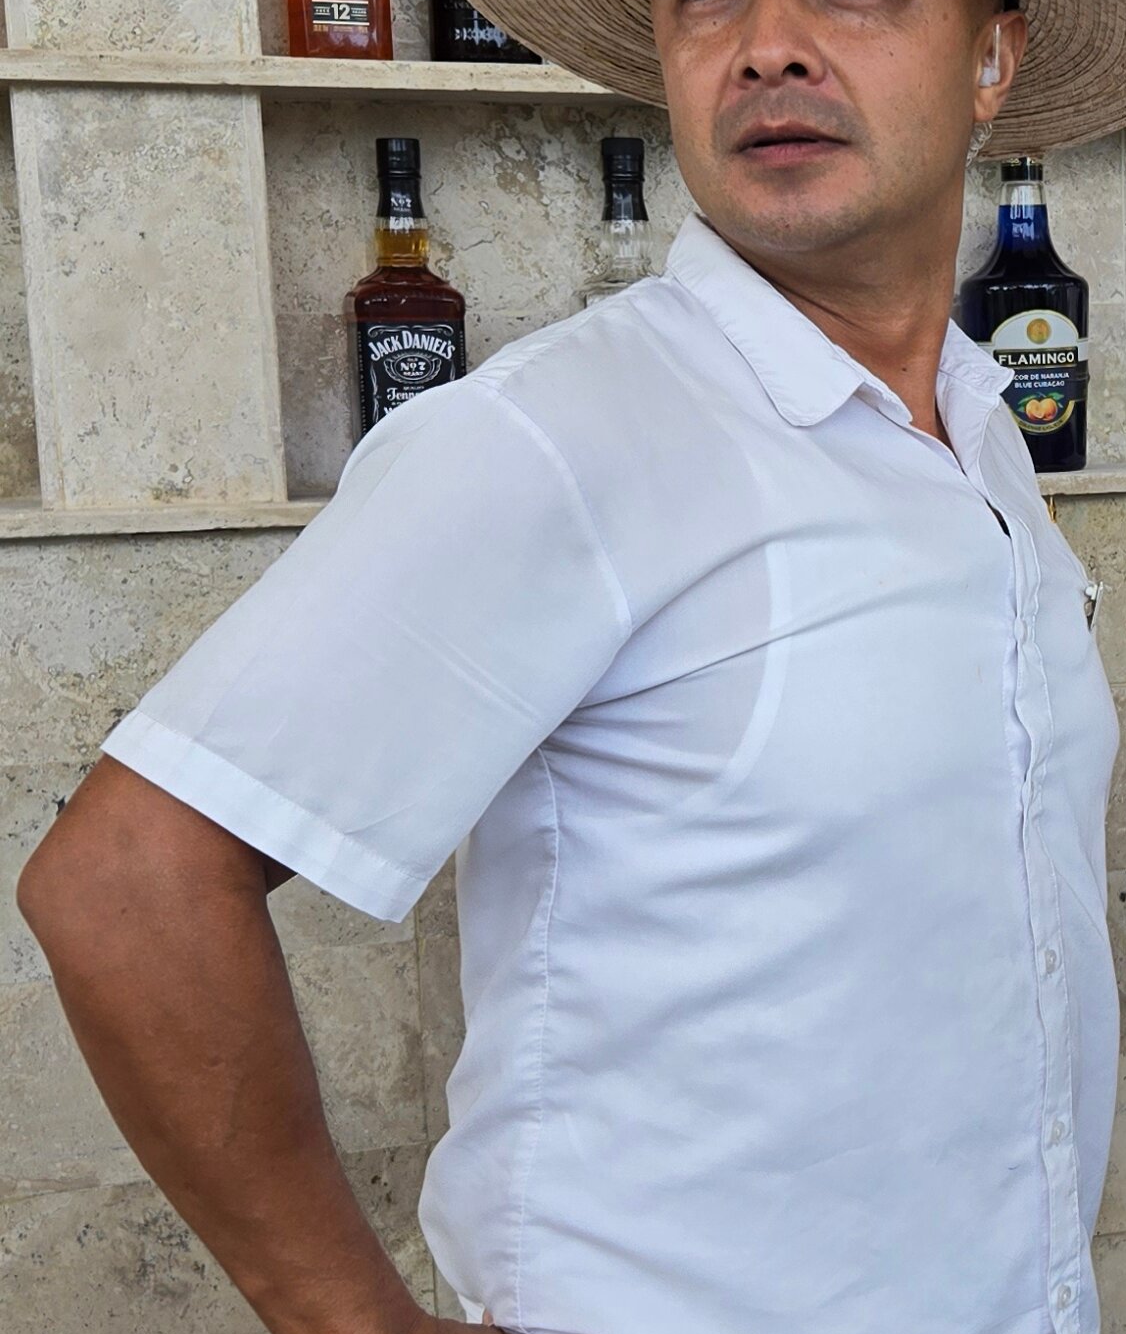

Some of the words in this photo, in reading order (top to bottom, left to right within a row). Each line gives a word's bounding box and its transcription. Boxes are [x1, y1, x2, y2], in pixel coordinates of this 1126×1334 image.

[330, 3, 351, 20] 12
[368, 334, 403, 362] JACK
[401, 330, 456, 360] DANIEL'S
[998, 351, 1075, 366] FLAMINGO
[1030, 373, 1040, 381] DE
[1040, 372, 1070, 380] NARANJA
[1014, 381, 1033, 389] BLUE
